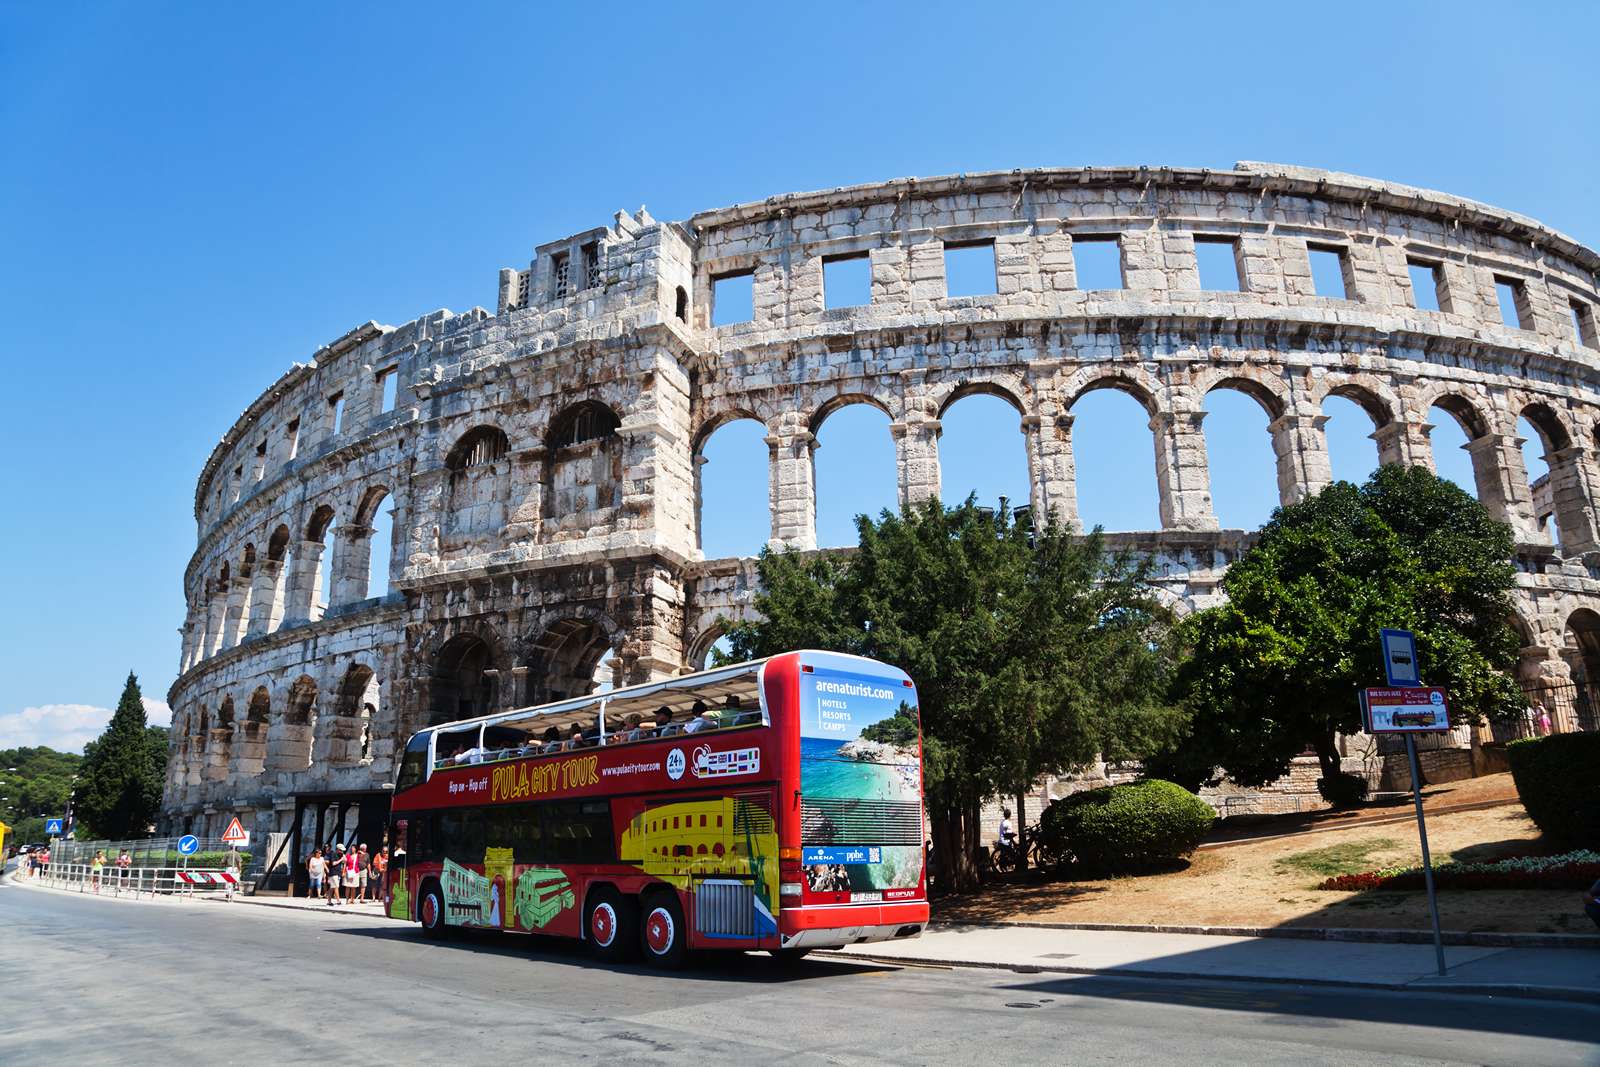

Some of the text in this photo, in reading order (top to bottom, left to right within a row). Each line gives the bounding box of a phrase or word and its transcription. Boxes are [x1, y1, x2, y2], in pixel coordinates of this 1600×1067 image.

[815, 680, 894, 700] arenaturist.com
[822, 699, 847, 710] HOTELS
[822, 711, 851, 721] RESORTS
[823, 722, 846, 731] CAMPS
[601, 762, 661, 777] www.pulacitytour.com
[492, 755, 599, 801] PULA CITY TOUR
[448, 780, 458, 795] Hop
[458, 783, 465, 792] on
[469, 778, 478, 793] Hop
[479, 776, 488, 790] off
[846, 849, 864, 862] pphe
